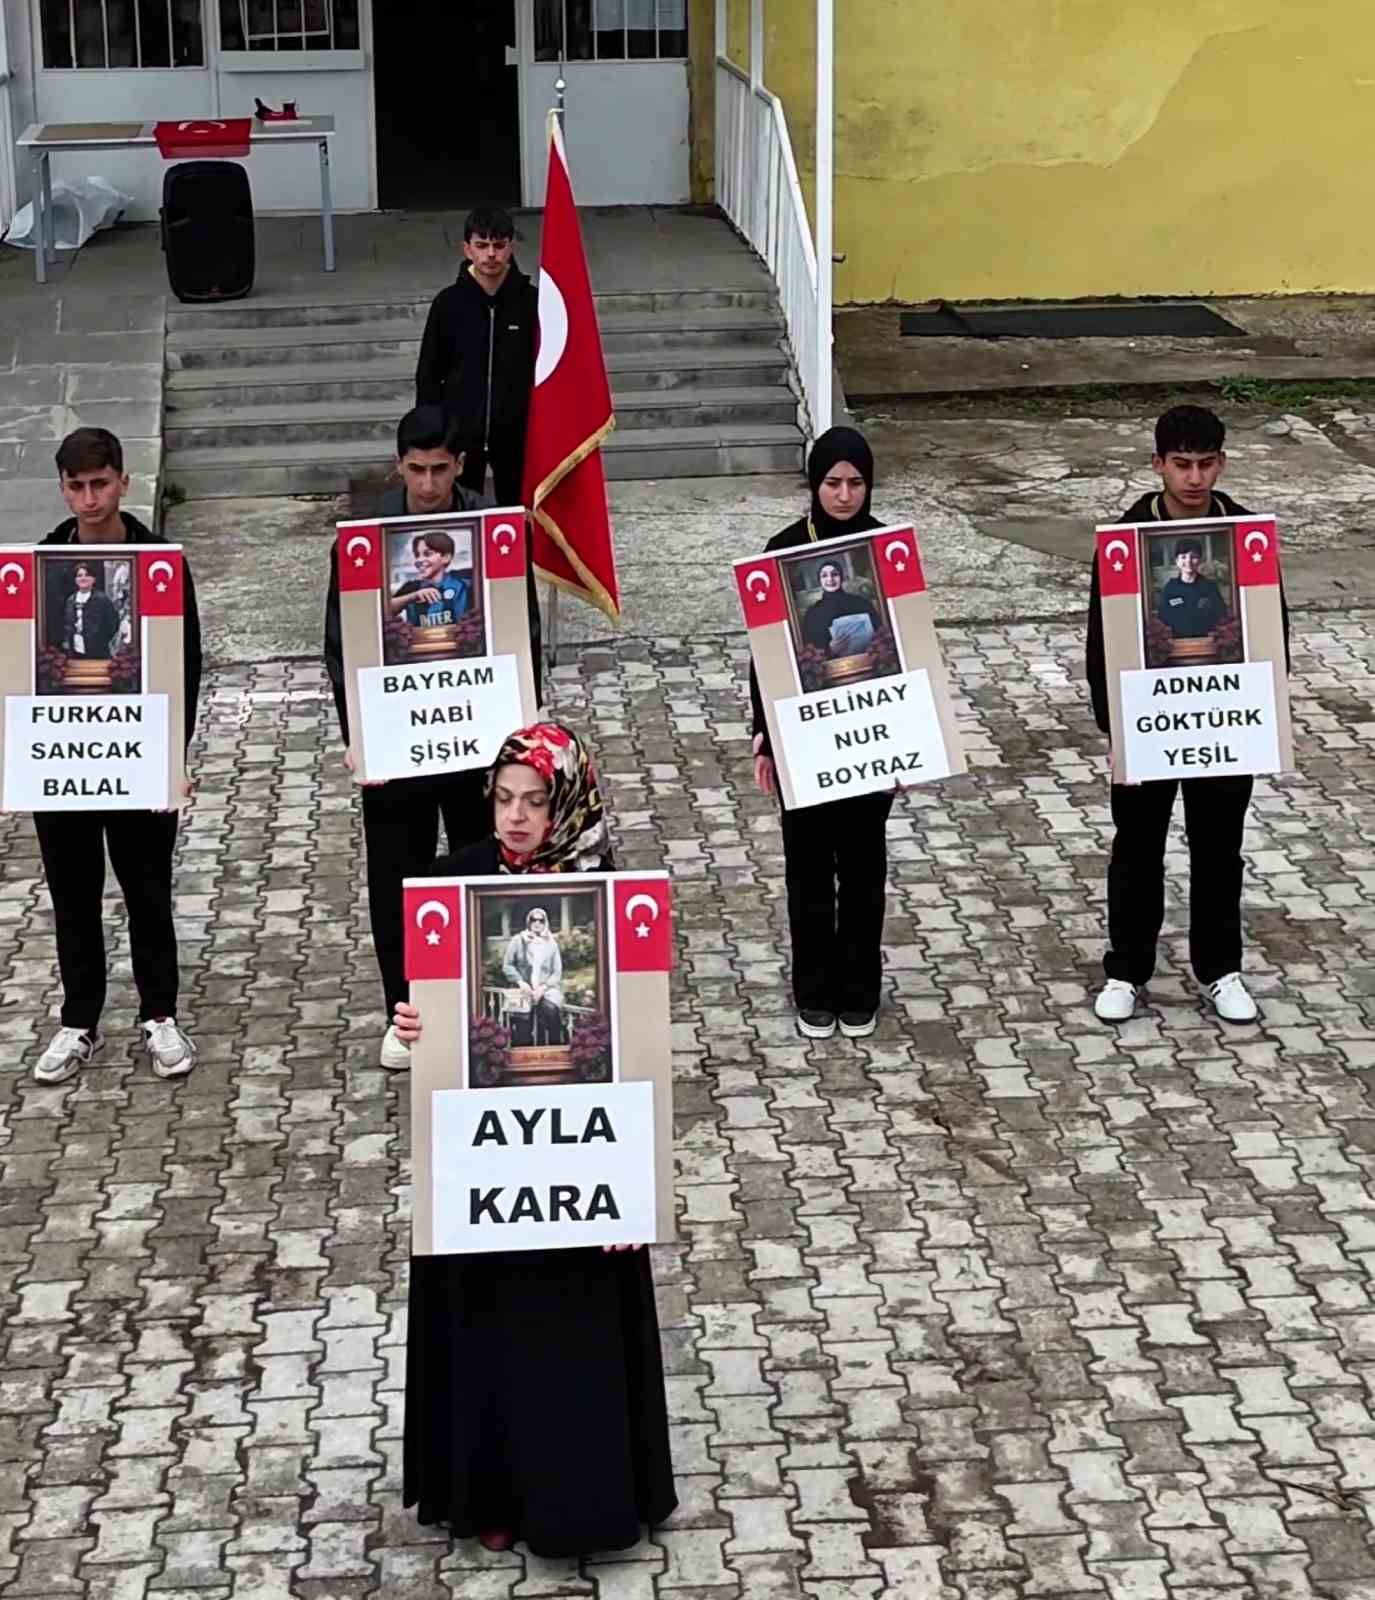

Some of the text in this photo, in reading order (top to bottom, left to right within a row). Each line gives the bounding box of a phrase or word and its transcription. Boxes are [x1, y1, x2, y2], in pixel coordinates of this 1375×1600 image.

[383, 666, 495, 694] BAYRAM
[1152, 673, 1240, 697] ADNAN
[31, 705, 142, 724] FURKAN
[410, 699, 473, 727] NABİ
[799, 684, 908, 722] BELİNAY
[1136, 708, 1262, 734] GÖKTÜRK
[31, 741, 142, 760] SANCAK
[834, 724, 889, 750] NUR
[410, 736, 481, 766] ŞİŞİK
[1163, 744, 1238, 769] YEŞİL
[817, 751, 923, 789] BOYRAZ
[43, 777, 130, 796] BALAL
[471, 1106, 617, 1147] AYLA
[469, 1183, 621, 1225] KARA
